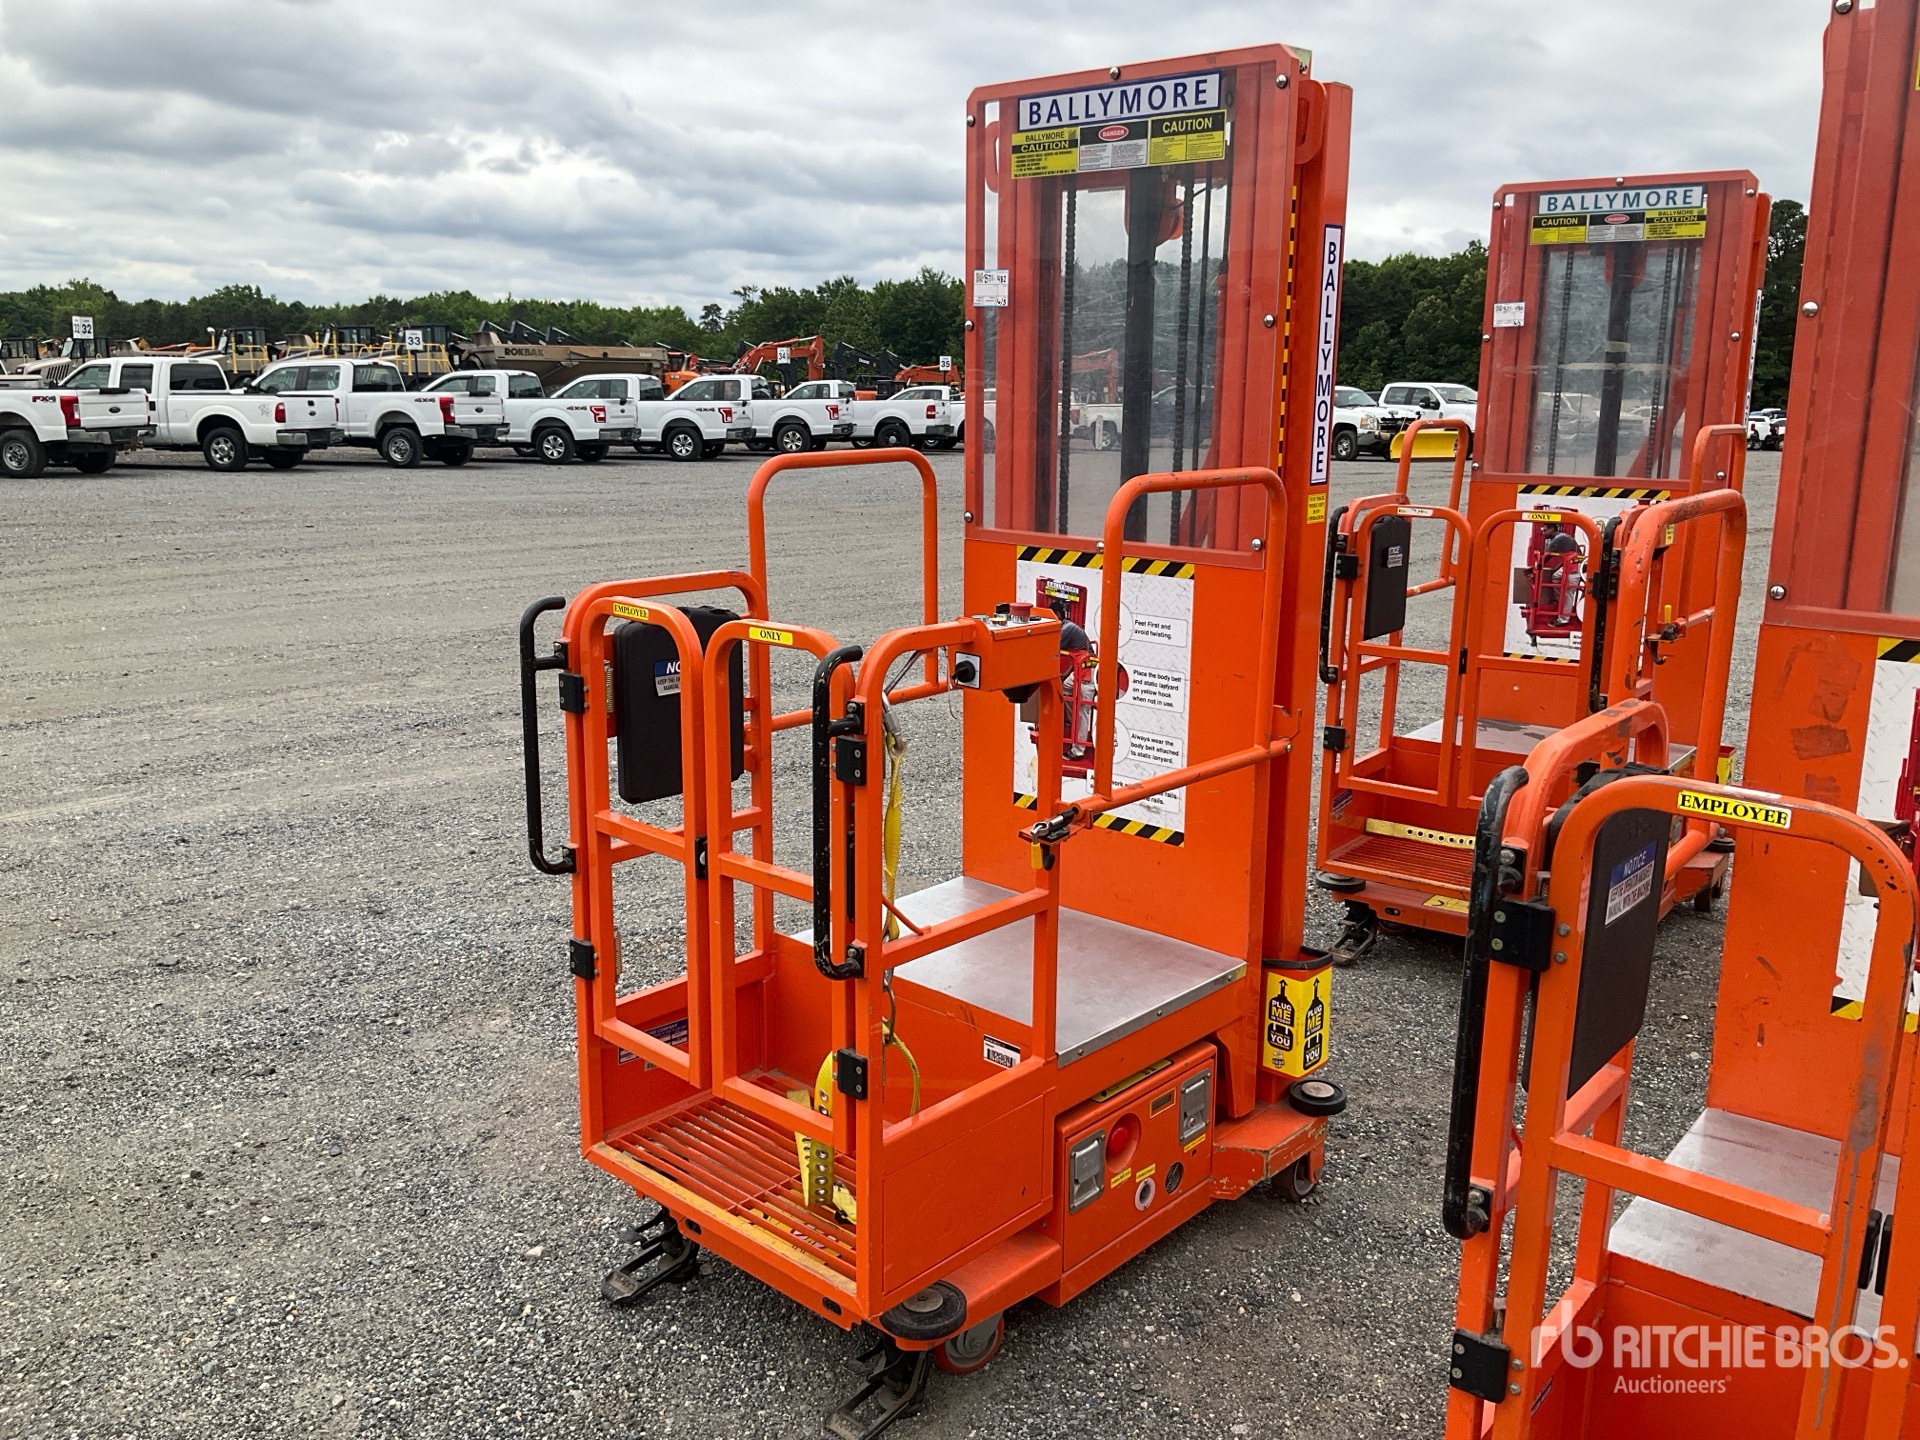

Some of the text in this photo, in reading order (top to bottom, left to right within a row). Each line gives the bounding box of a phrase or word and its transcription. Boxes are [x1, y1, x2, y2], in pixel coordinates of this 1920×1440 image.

[1029, 79, 1208, 126] BALLYMORE
[1162, 117, 1213, 134] CAUTION
[1025, 131, 1065, 143] BALLYMORE
[1102, 129, 1125, 137] DANGER
[1021, 140, 1069, 152] CAUTION
[1547, 189, 1694, 212] BALLYMORE
[1541, 217, 1579, 226] CAUTION
[1653, 215, 1698, 223] CAUTION
[82, 324, 92, 334] 32
[408, 336, 421, 346] 33
[504, 347, 544, 356] ROKBAK
[1315, 241, 1337, 473] BALLYMORE
[941, 360, 951, 368] 35
[32, 395, 57, 403] FX4
[614, 604, 648, 618] EMPLOYEE
[1147, 621, 1160, 629] First
[760, 629, 782, 641] ONLY
[1150, 630, 1172, 640] twisting.
[1133, 669, 1182, 683] Place the body belt
[1144, 680, 1158, 688] static
[1159, 682, 1179, 691] lanyard
[1158, 689, 1172, 698] hook
[1132, 695, 1147, 703] when
[1147, 697, 1156, 705] not
[1131, 733, 1150, 742] Always
[1165, 739, 1174, 747] the
[1131, 741, 1179, 756] body belt attached
[1137, 751, 1151, 759] static
[1152, 753, 1174, 764] lanyard.
[1679, 793, 1789, 826] EMPLOYEE
[1623, 850, 1648, 879] NOTICE
[1271, 1000, 1292, 1012] PLUG
[1307, 1004, 1323, 1019] PLUG
[1271, 1006, 1292, 1022] ME
[1307, 1012, 1322, 1031] ME
[1270, 1033, 1291, 1047] YOU
[1305, 1047, 1320, 1063] YOU
